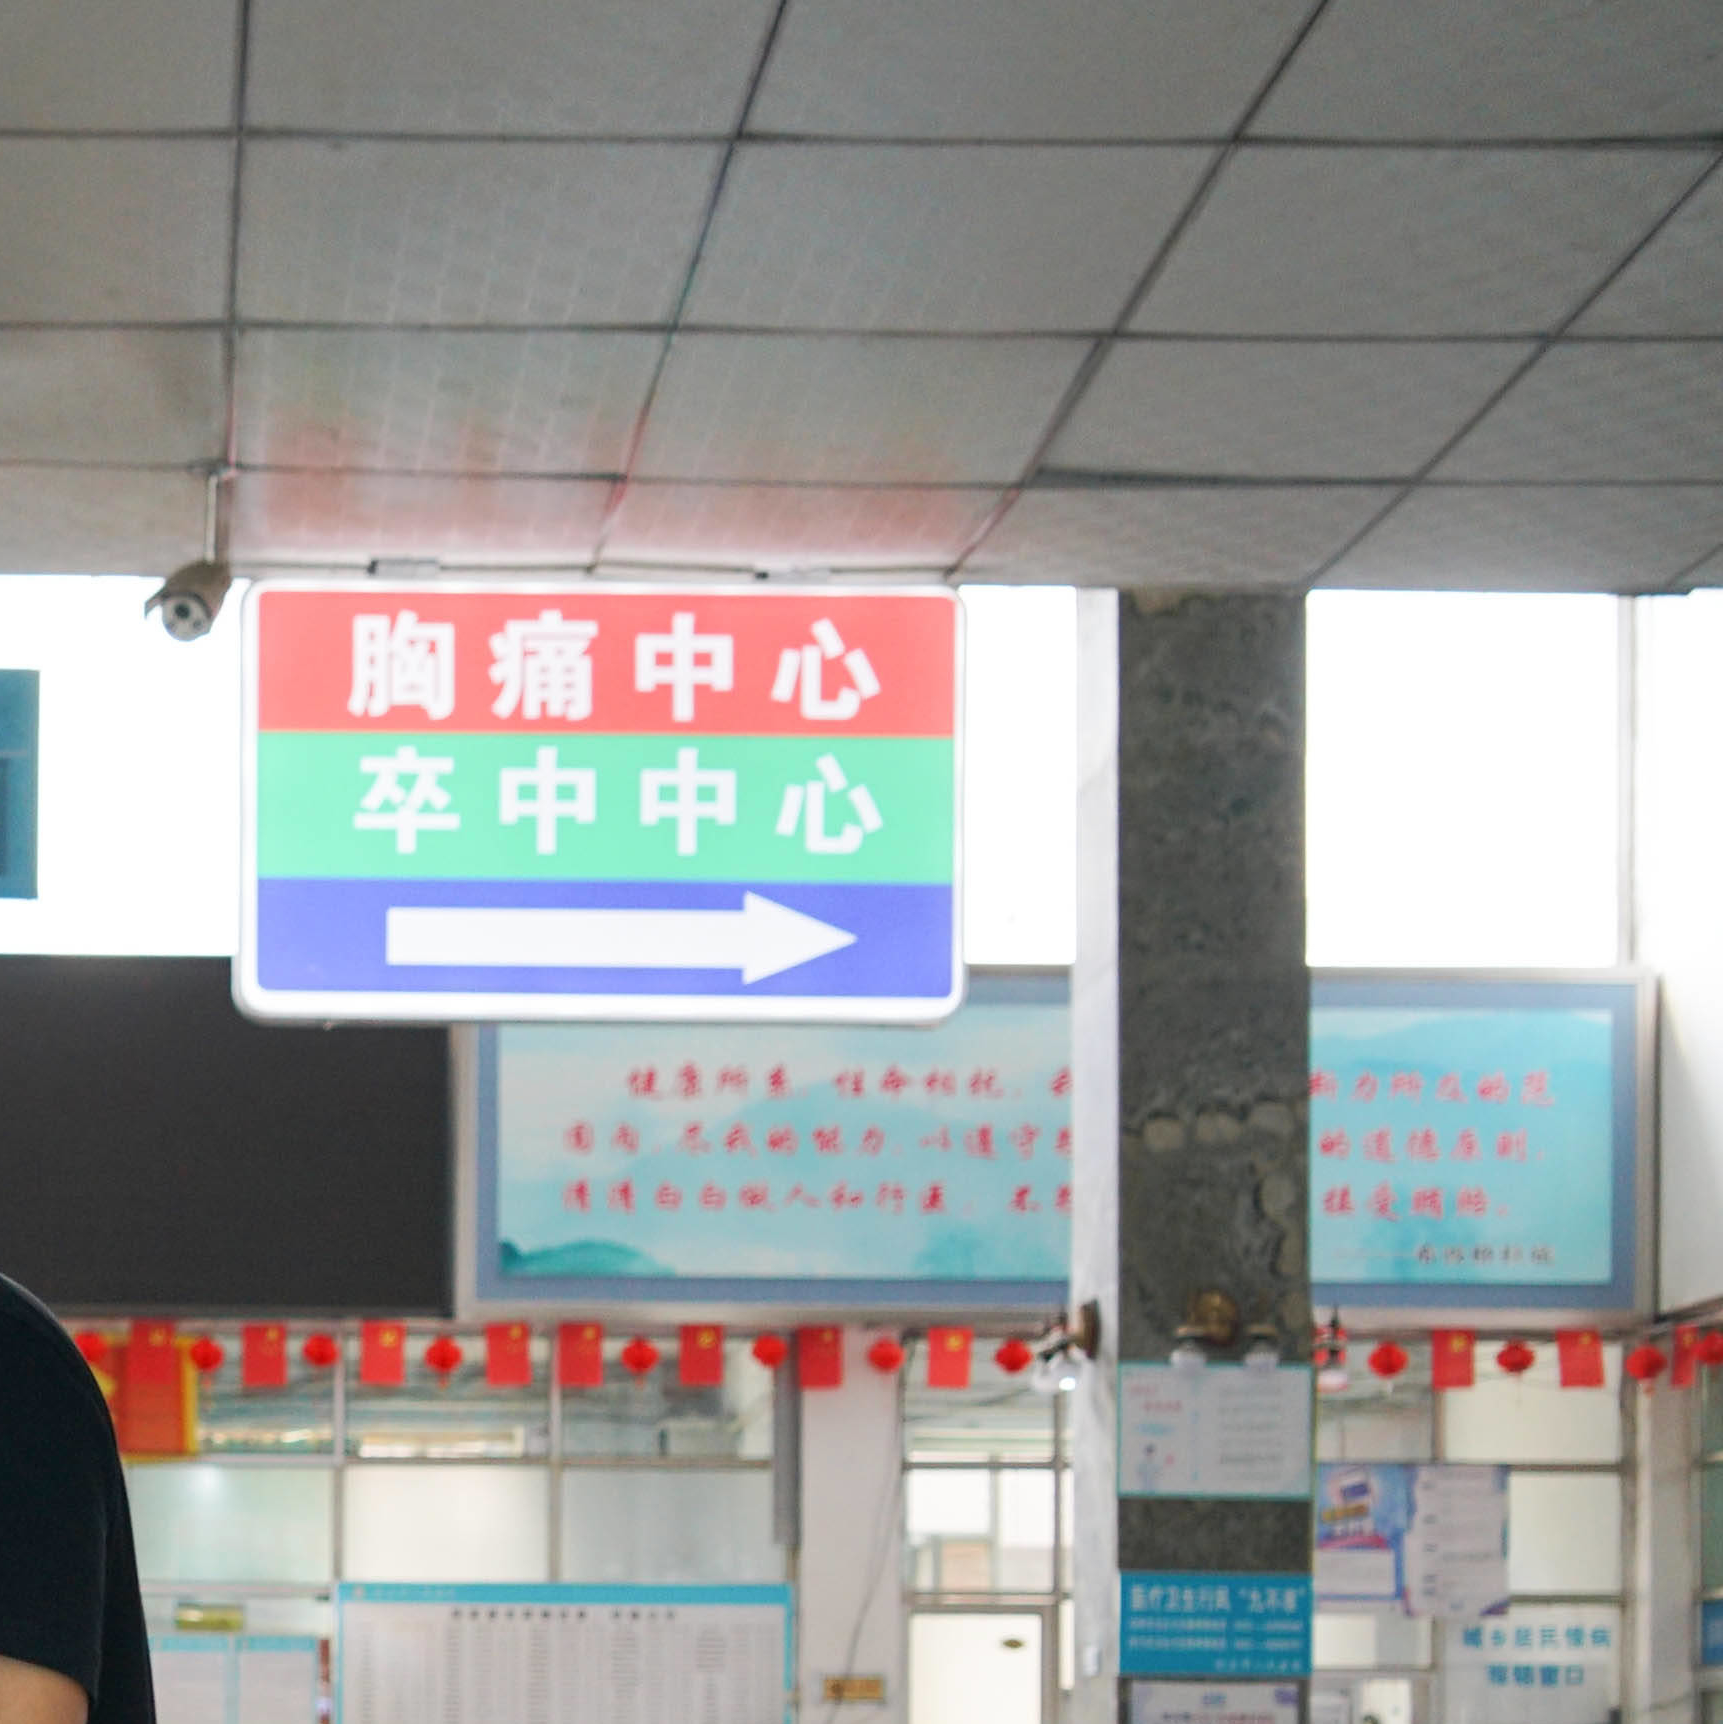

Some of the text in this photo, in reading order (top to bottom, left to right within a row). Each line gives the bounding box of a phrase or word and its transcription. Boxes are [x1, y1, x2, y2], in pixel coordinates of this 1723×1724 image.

[348, 610, 881, 722] 胸痛中心
[354, 746, 883, 855] 卒中中心
